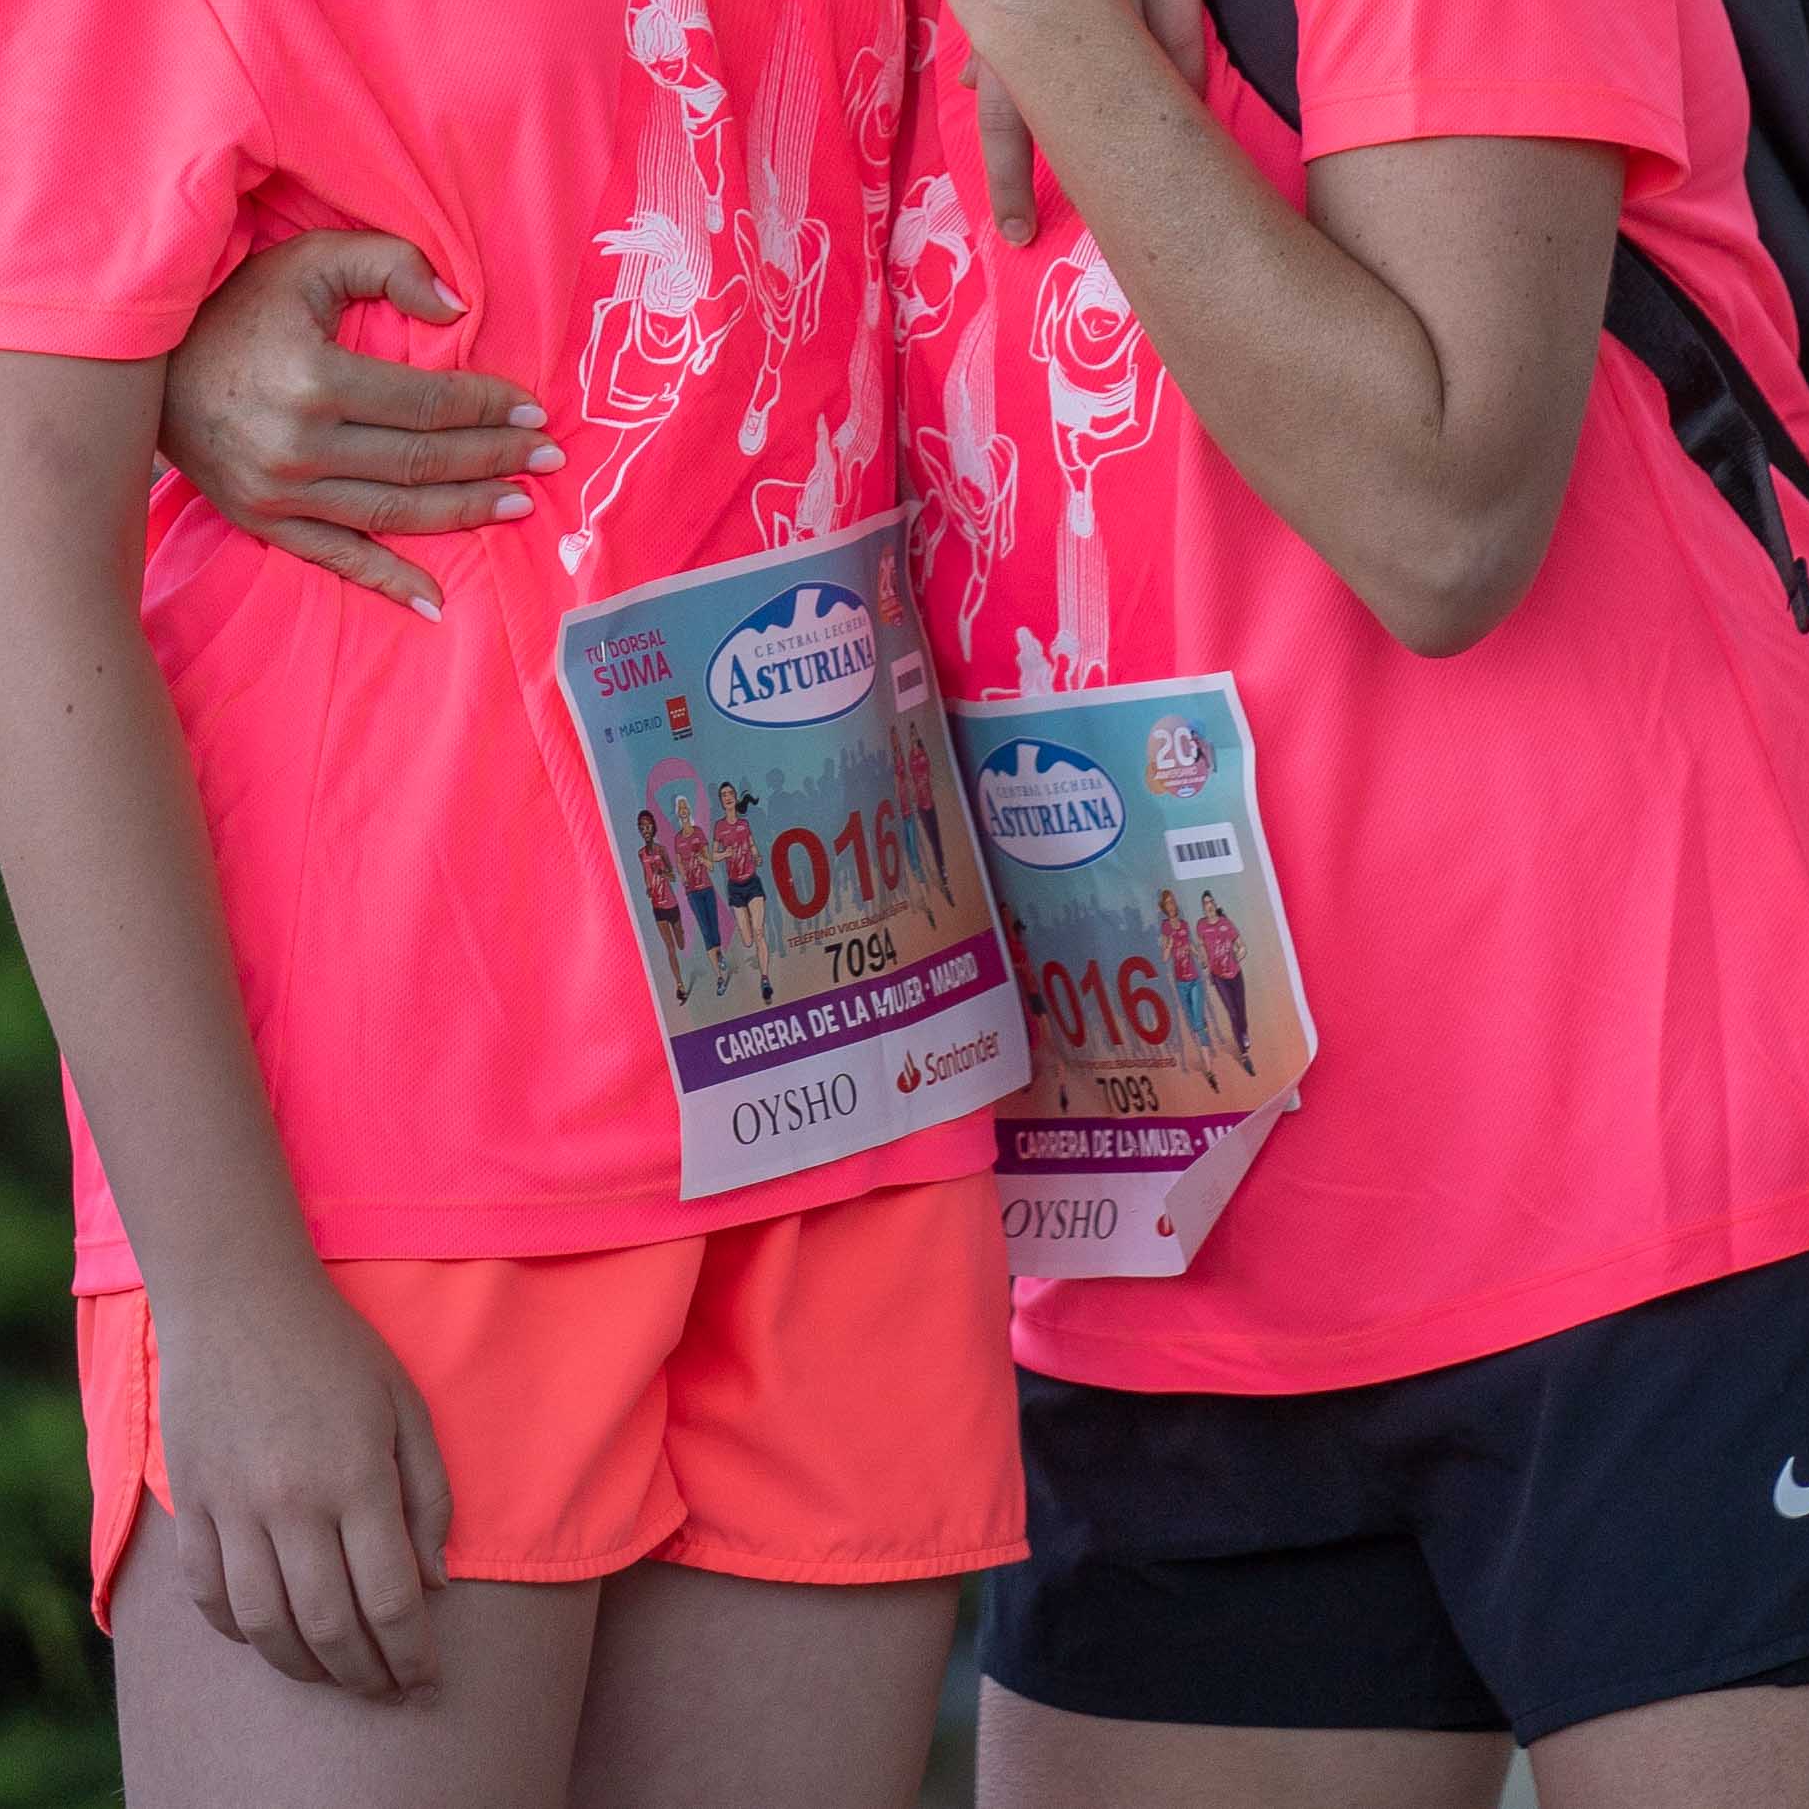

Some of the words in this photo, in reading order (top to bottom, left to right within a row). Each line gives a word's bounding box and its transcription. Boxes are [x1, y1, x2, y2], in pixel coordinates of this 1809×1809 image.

[584, 642, 605, 664] TU
[608, 628, 667, 659] DORSAL
[754, 631, 819, 658] CENTRAL
[594, 651, 673, 697] SUMA
[728, 635, 876, 708] ASTURIANA
[619, 716, 663, 737] MADRID
[1045, 778, 1103, 796] LECHERA
[986, 790, 1117, 838] ASTURIANA
[771, 798, 900, 920] 016
[824, 927, 898, 984] 7094
[715, 1013, 808, 1066] CARRERA
[808, 1004, 841, 1037] DE
[840, 995, 871, 1028] LA
[870, 976, 927, 1019] MUJER
[929, 951, 979, 997] MADRID
[1043, 955, 1172, 1048] 016
[925, 1029, 1000, 1087] Santander
[732, 1073, 858, 1145] OYSHO
[1096, 1075, 1160, 1114] 7093
[1015, 1129, 1090, 1160] CARRERA
[1091, 1129, 1114, 1158] DE
[1138, 1128, 1194, 1157] MUJER
[1003, 1198, 1118, 1240] OYSHO
